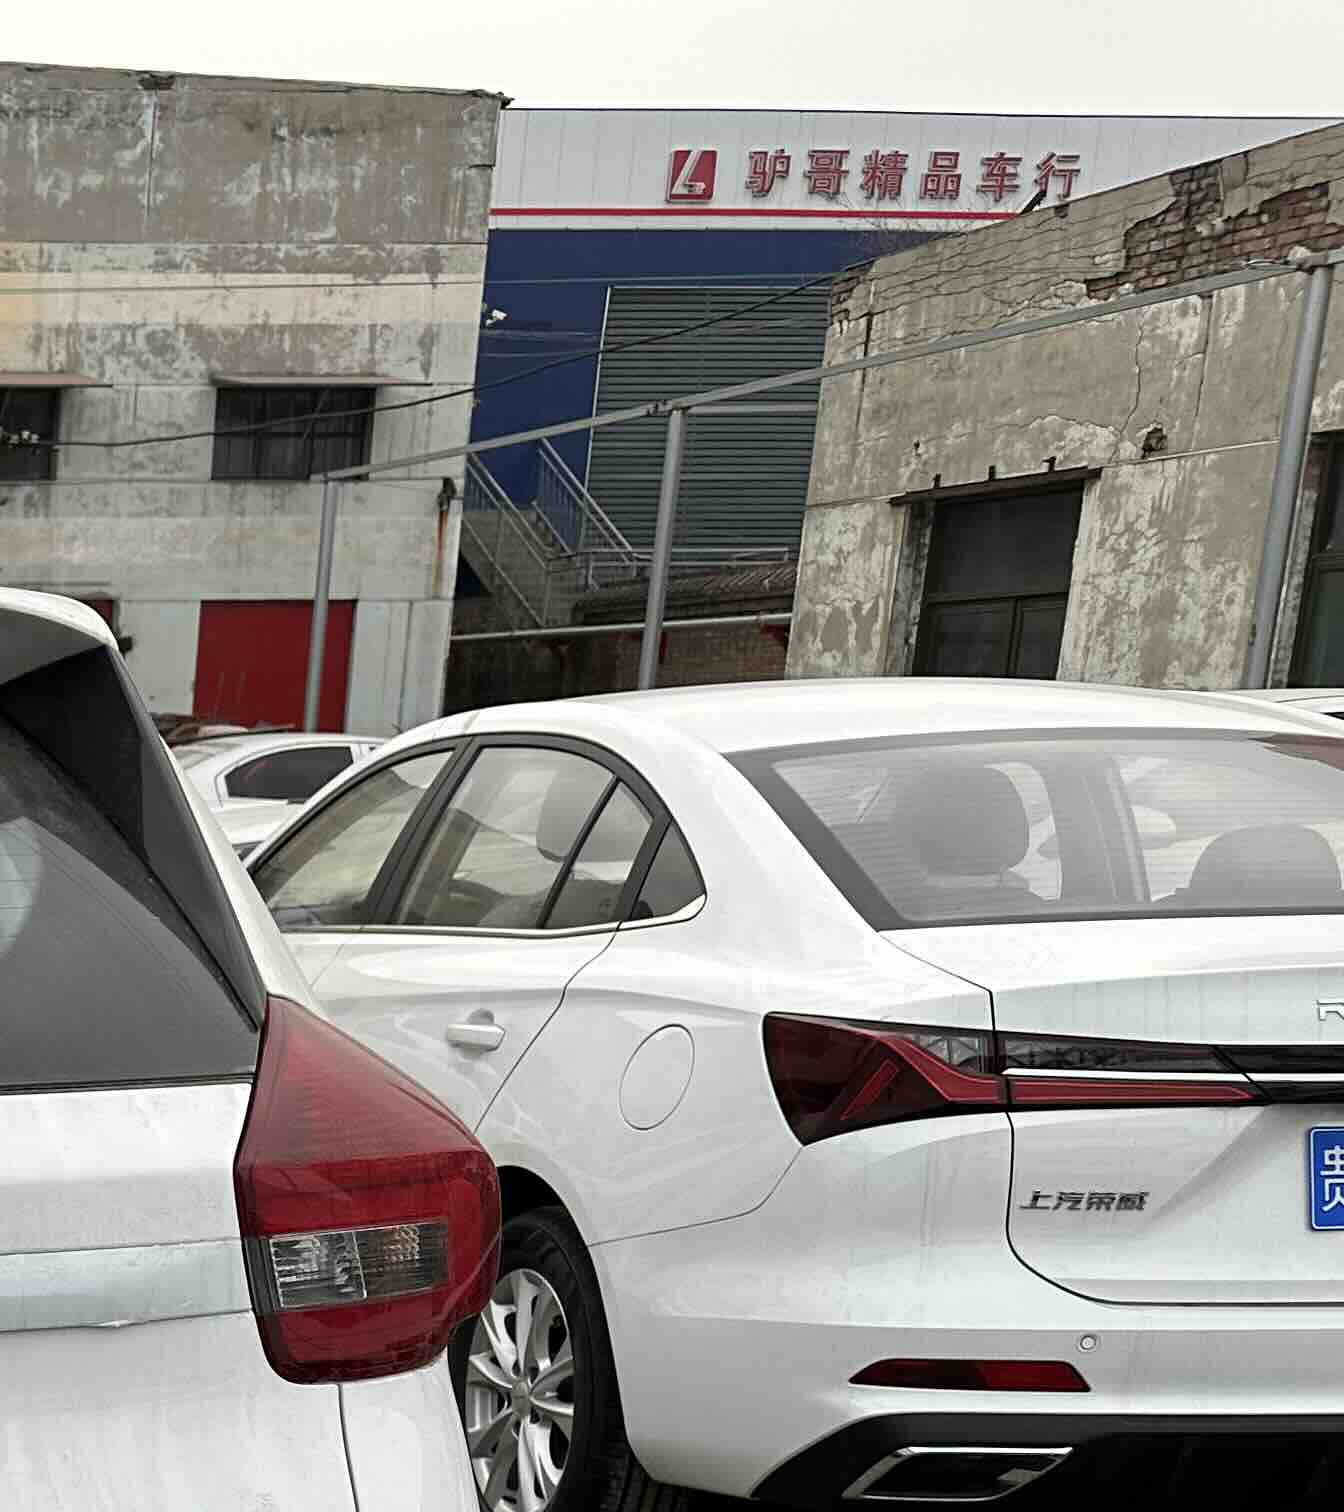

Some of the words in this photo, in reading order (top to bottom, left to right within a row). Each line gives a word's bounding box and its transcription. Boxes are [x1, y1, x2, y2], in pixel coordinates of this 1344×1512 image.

[745, 149, 1081, 201] 驴哥精品车行
[1018, 1190, 1150, 1212] 上汽荣威
